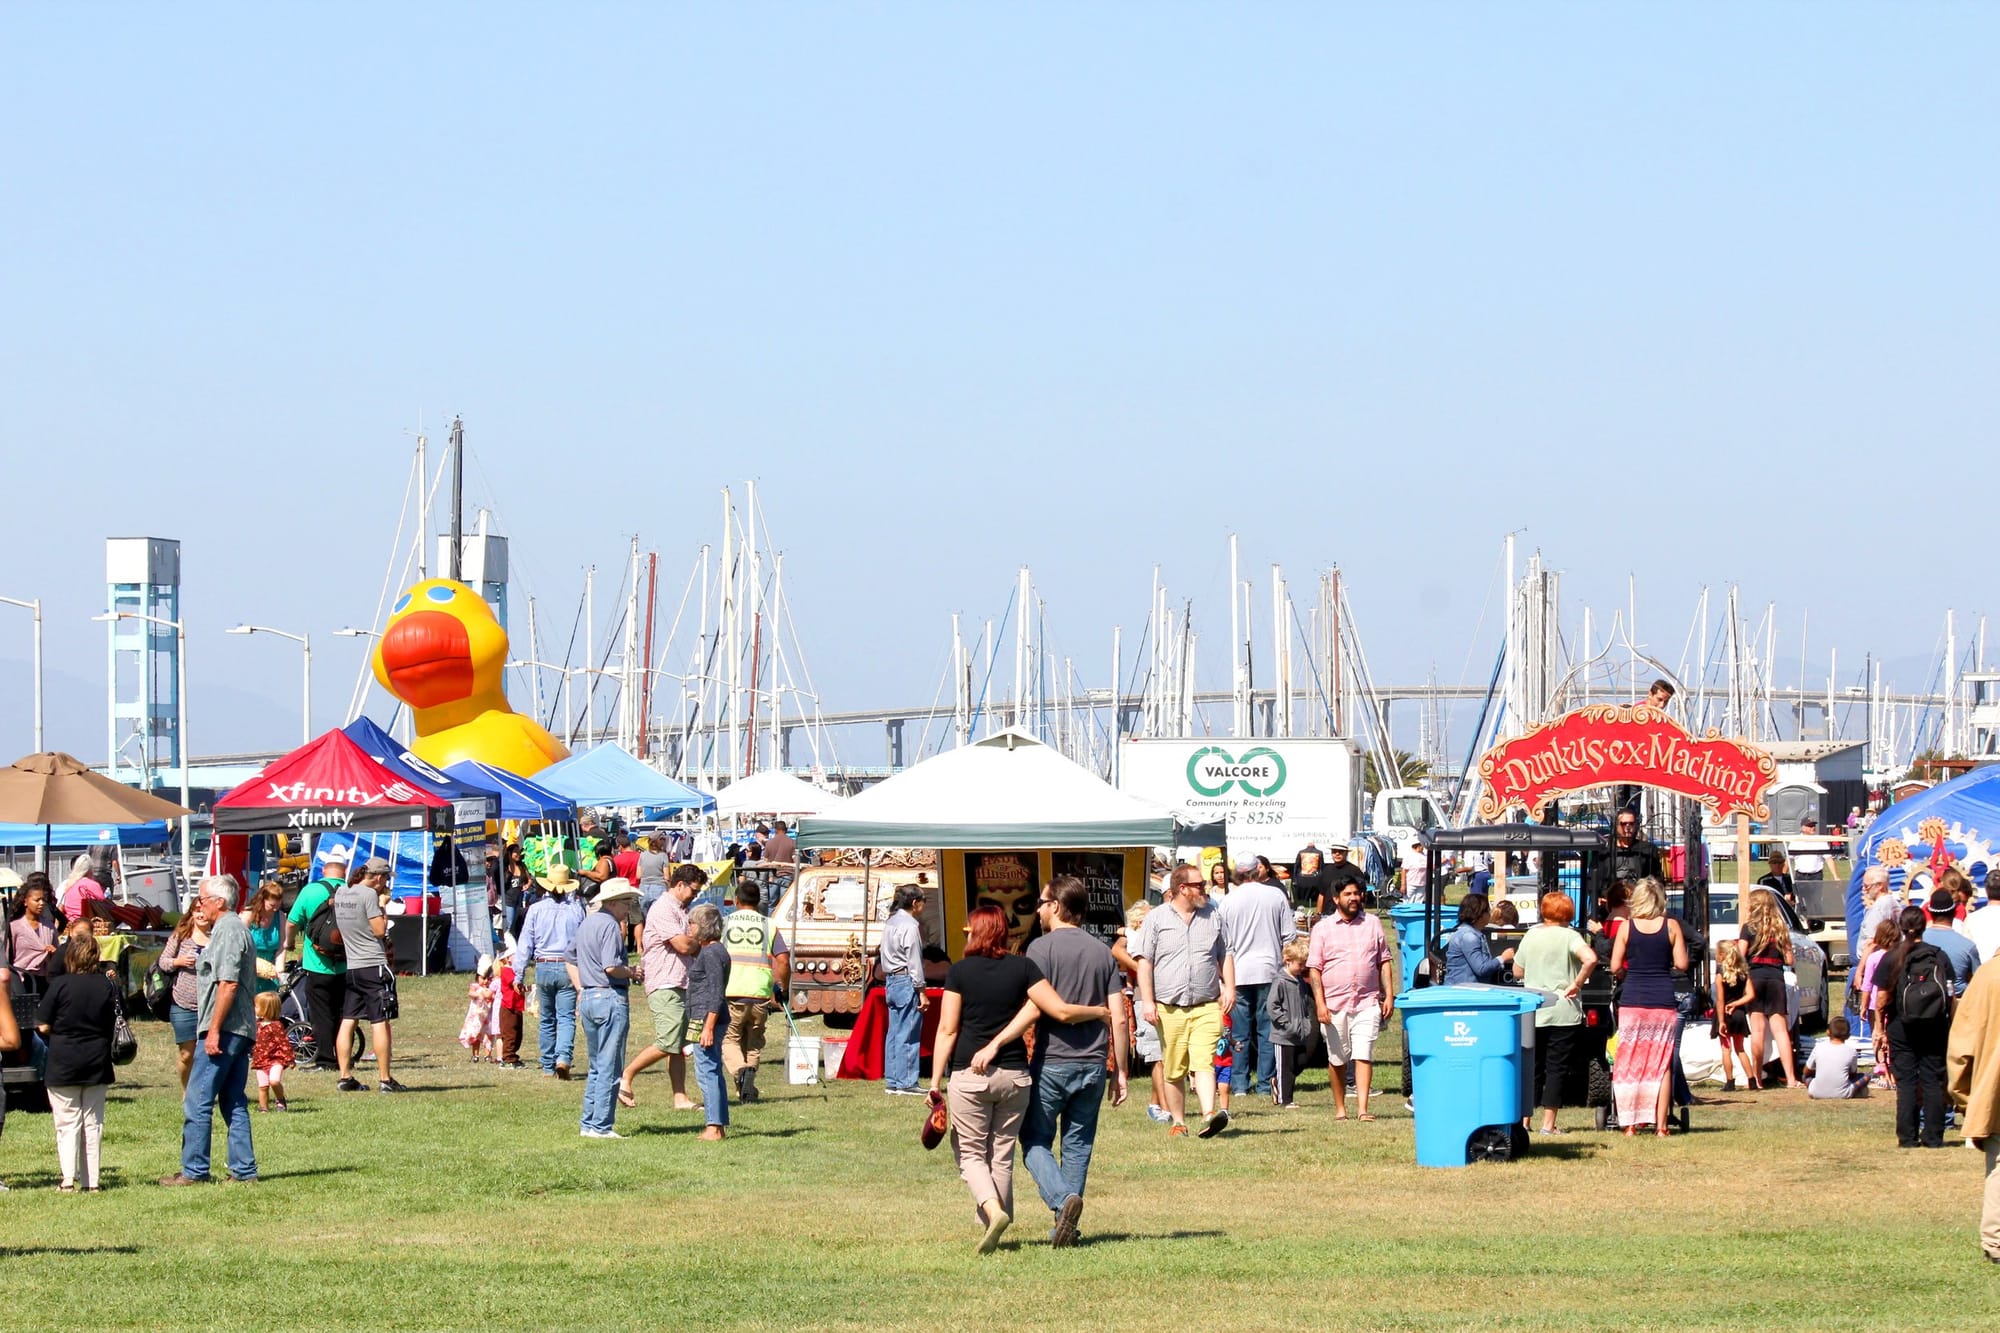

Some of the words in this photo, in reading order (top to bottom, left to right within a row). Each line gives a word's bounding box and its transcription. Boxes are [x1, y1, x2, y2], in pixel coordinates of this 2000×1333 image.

[1205, 766, 1269, 778] VALCORE
[267, 782, 384, 805] xfinity
[1186, 799, 1239, 808] Community
[1243, 799, 1287, 808] Recycling
[1211, 811, 1284, 825] 5-8258
[1924, 825, 1943, 839] 100
[1883, 846, 1903, 860] 75
[1083, 877, 1119, 891] LTESE
[1088, 892, 1119, 906] ULHU
